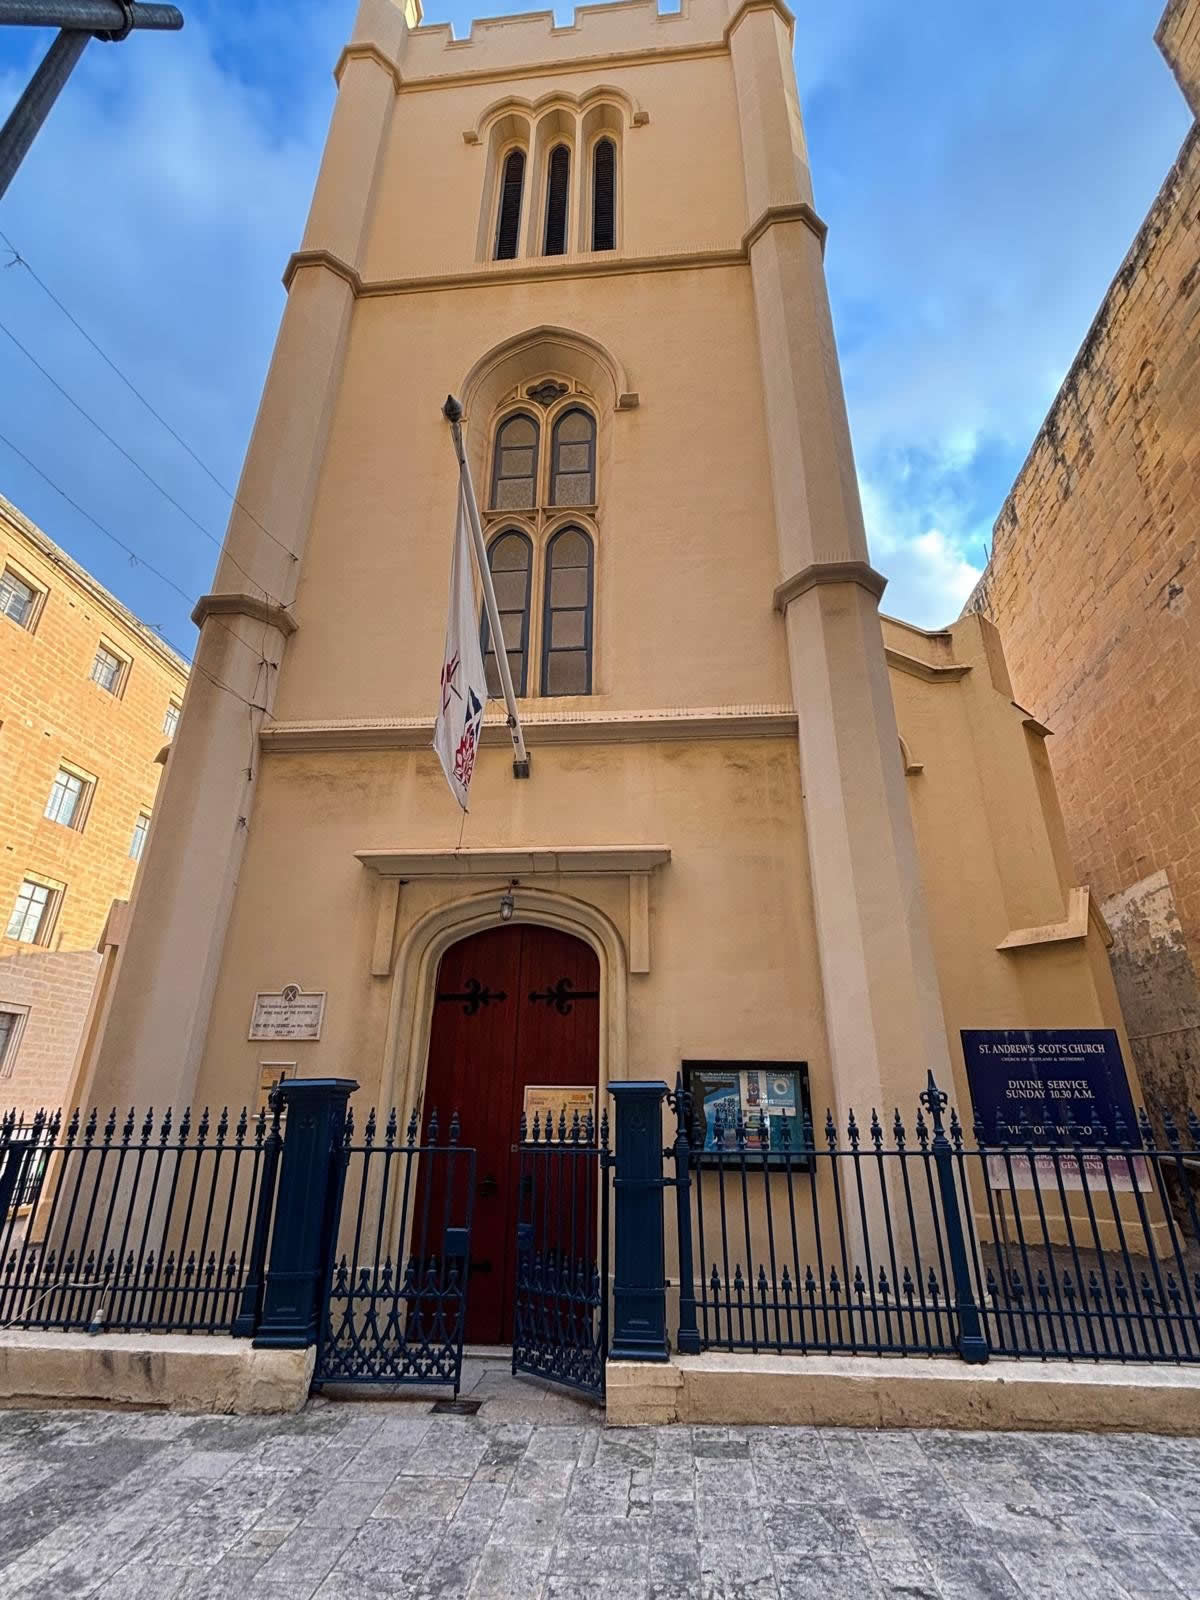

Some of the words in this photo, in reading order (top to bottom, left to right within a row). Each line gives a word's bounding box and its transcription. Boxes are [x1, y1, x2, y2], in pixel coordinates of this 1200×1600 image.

[978, 1044, 991, 1054] ST.
[992, 1044, 1036, 1054] ANDREW'S
[1037, 1044, 1068, 1054] SCOT'S
[1068, 1043, 1105, 1053] CHURCH
[1008, 1080, 1044, 1089] DIVINE
[1047, 1080, 1089, 1089] SERVICE
[1005, 1090, 1046, 1099] SUNDAY
[1050, 1090, 1072, 1099] 10.30
[1073, 1090, 1096, 1099] A.M.
